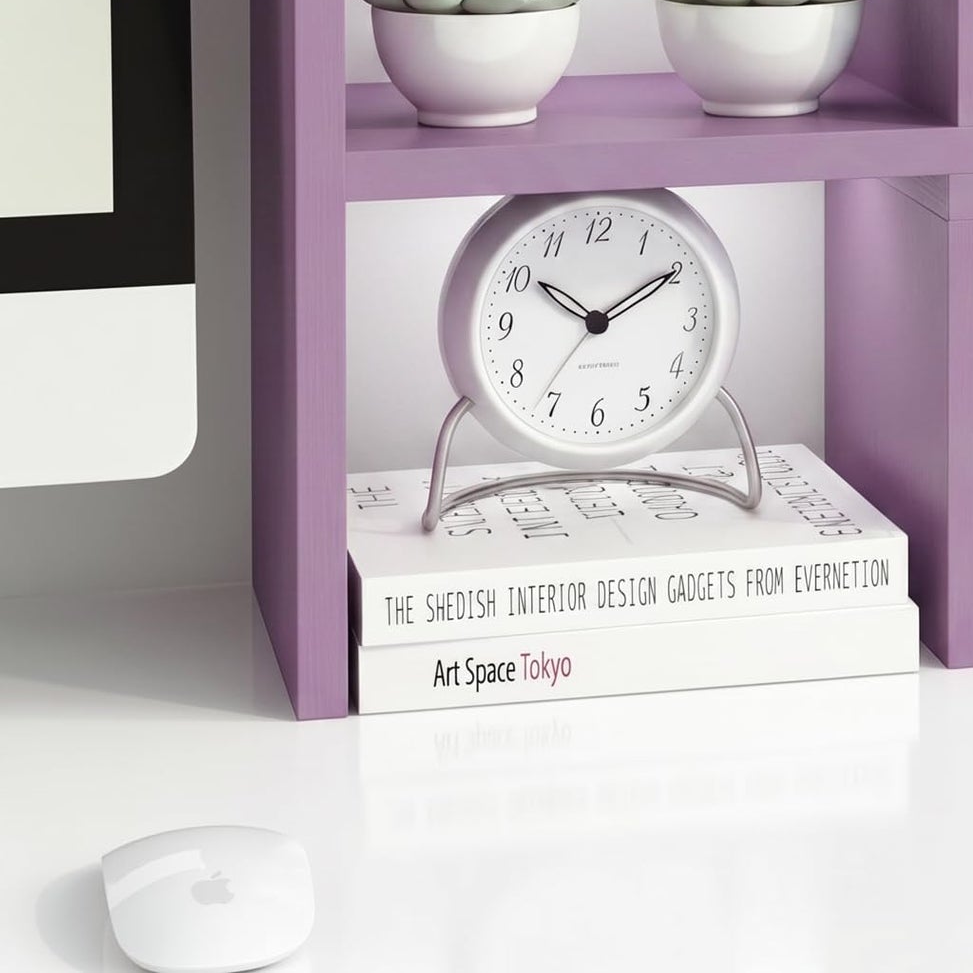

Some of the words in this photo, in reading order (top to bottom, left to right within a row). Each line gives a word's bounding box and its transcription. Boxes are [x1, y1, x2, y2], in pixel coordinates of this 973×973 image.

[586, 216, 612, 244] 12
[639, 229, 649, 255] 1
[543, 231, 565, 258] 11
[506, 265, 531, 293] 10
[668, 261, 683, 285] 2
[497, 312, 513, 341] 9
[683, 307, 698, 332] 3
[510, 359, 524, 388] 8
[669, 351, 684, 379] 4
[548, 391, 561, 417] 7
[591, 397, 604, 427] 6
[635, 386, 650, 411] 5
[385, 595, 415, 626] THE
[426, 589, 496, 623] SHEDISH
[508, 582, 587, 616] INTERIOR
[597, 576, 657, 609] DESIGN
[667, 570, 736, 604] GADGETS
[746, 566, 784, 598] FROM
[795, 558, 890, 594] EVERNETION
[433, 659, 460, 688] Art
[465, 657, 516, 693] Space
[520, 651, 572, 687] Tokyo
